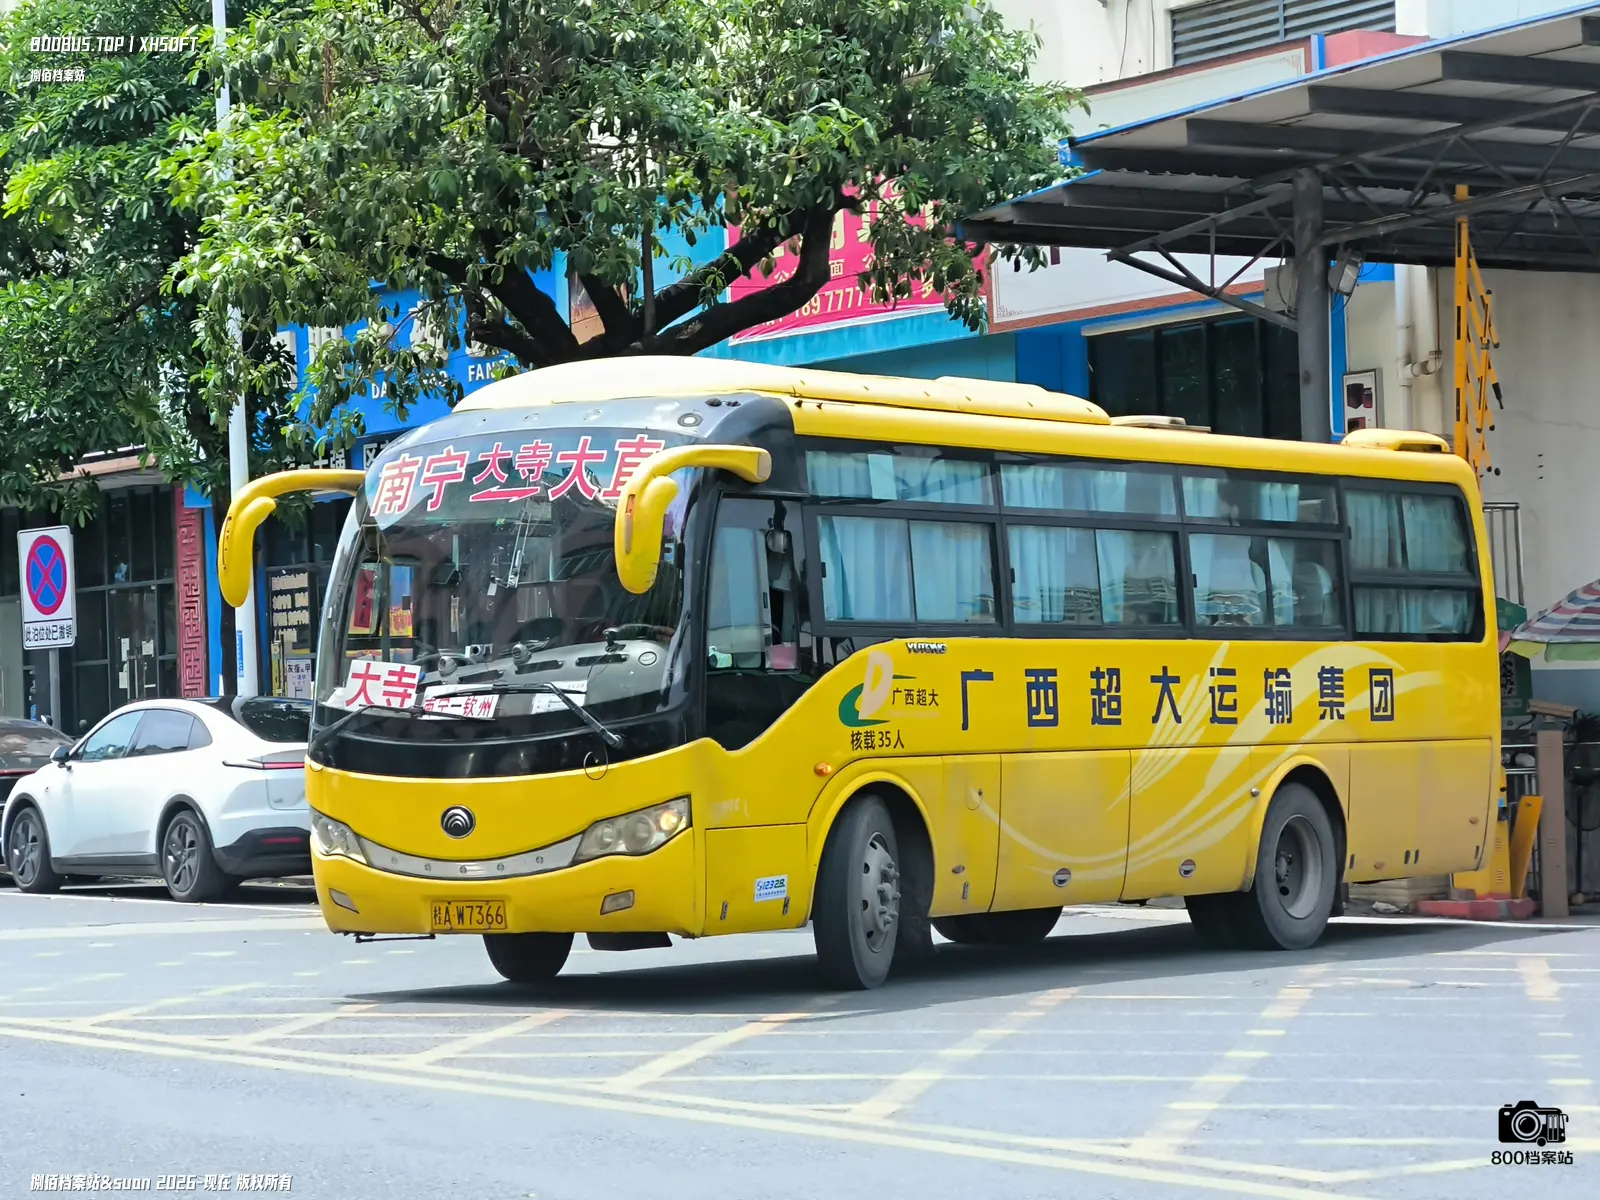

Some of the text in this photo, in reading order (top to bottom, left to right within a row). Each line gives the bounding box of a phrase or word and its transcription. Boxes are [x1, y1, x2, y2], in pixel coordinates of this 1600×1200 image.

[369, 445, 470, 517] 南宁
[472, 439, 552, 485] 大寺
[345, 662, 417, 708] 大寺
[891, 687, 940, 707] 广西超大
[961, 665, 1394, 731] 广西超大运输集团
[850, 729, 905, 751] 核载35人
